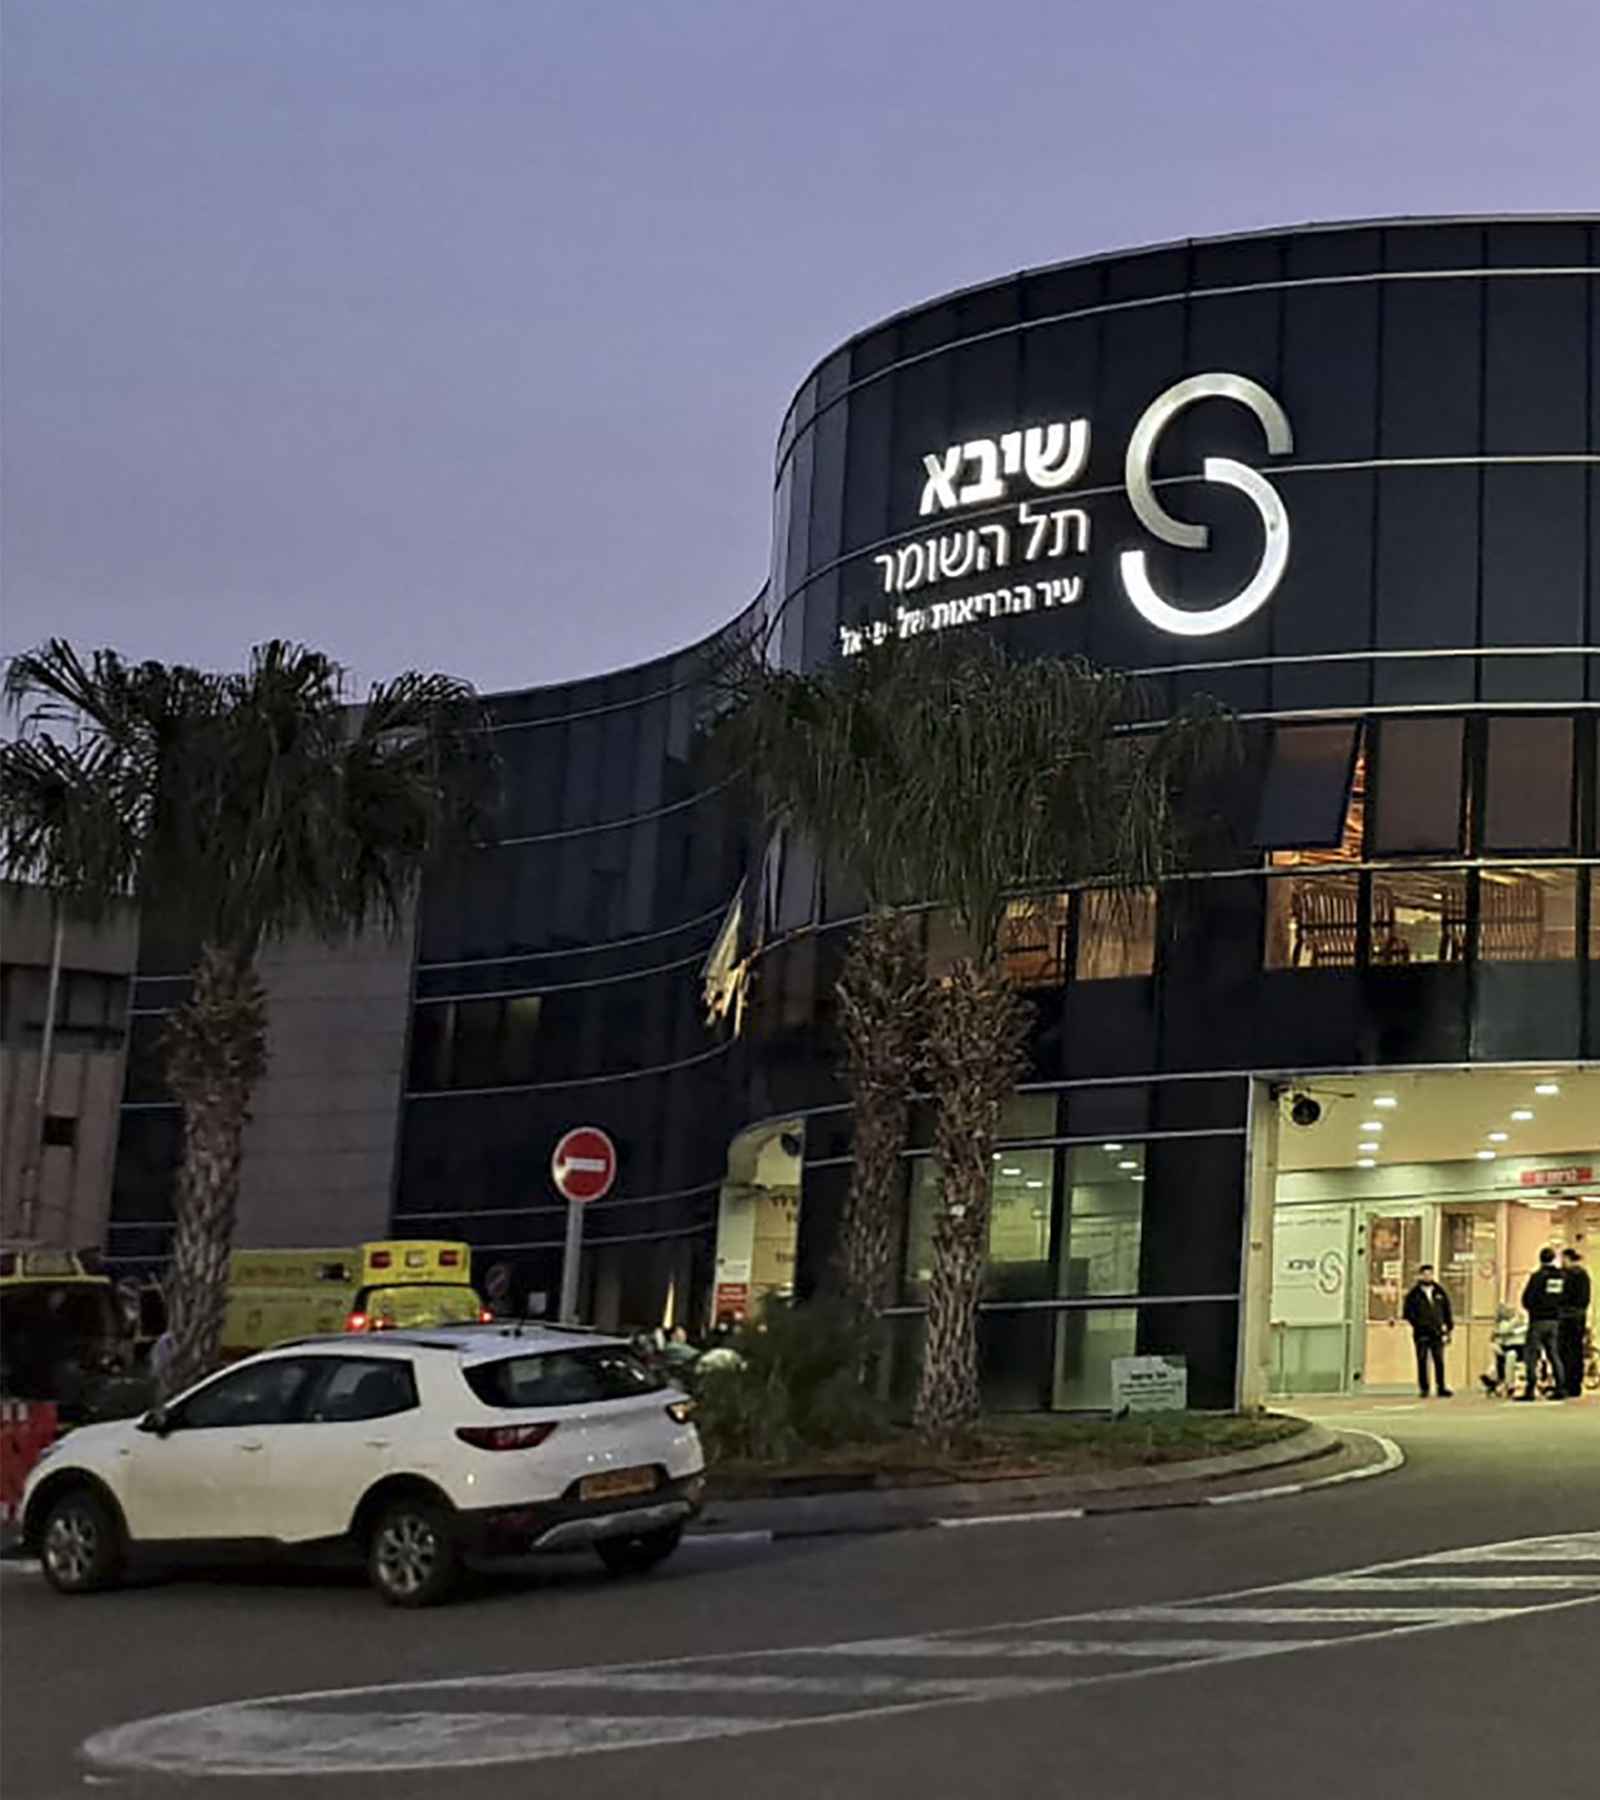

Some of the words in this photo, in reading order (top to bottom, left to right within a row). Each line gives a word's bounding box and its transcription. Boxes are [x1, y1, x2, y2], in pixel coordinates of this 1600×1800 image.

[918, 417, 1092, 517] שיבא
[873, 521, 1009, 593] השומר
[1018, 503, 1090, 561] תל
[1036, 575, 1083, 607] עיר
